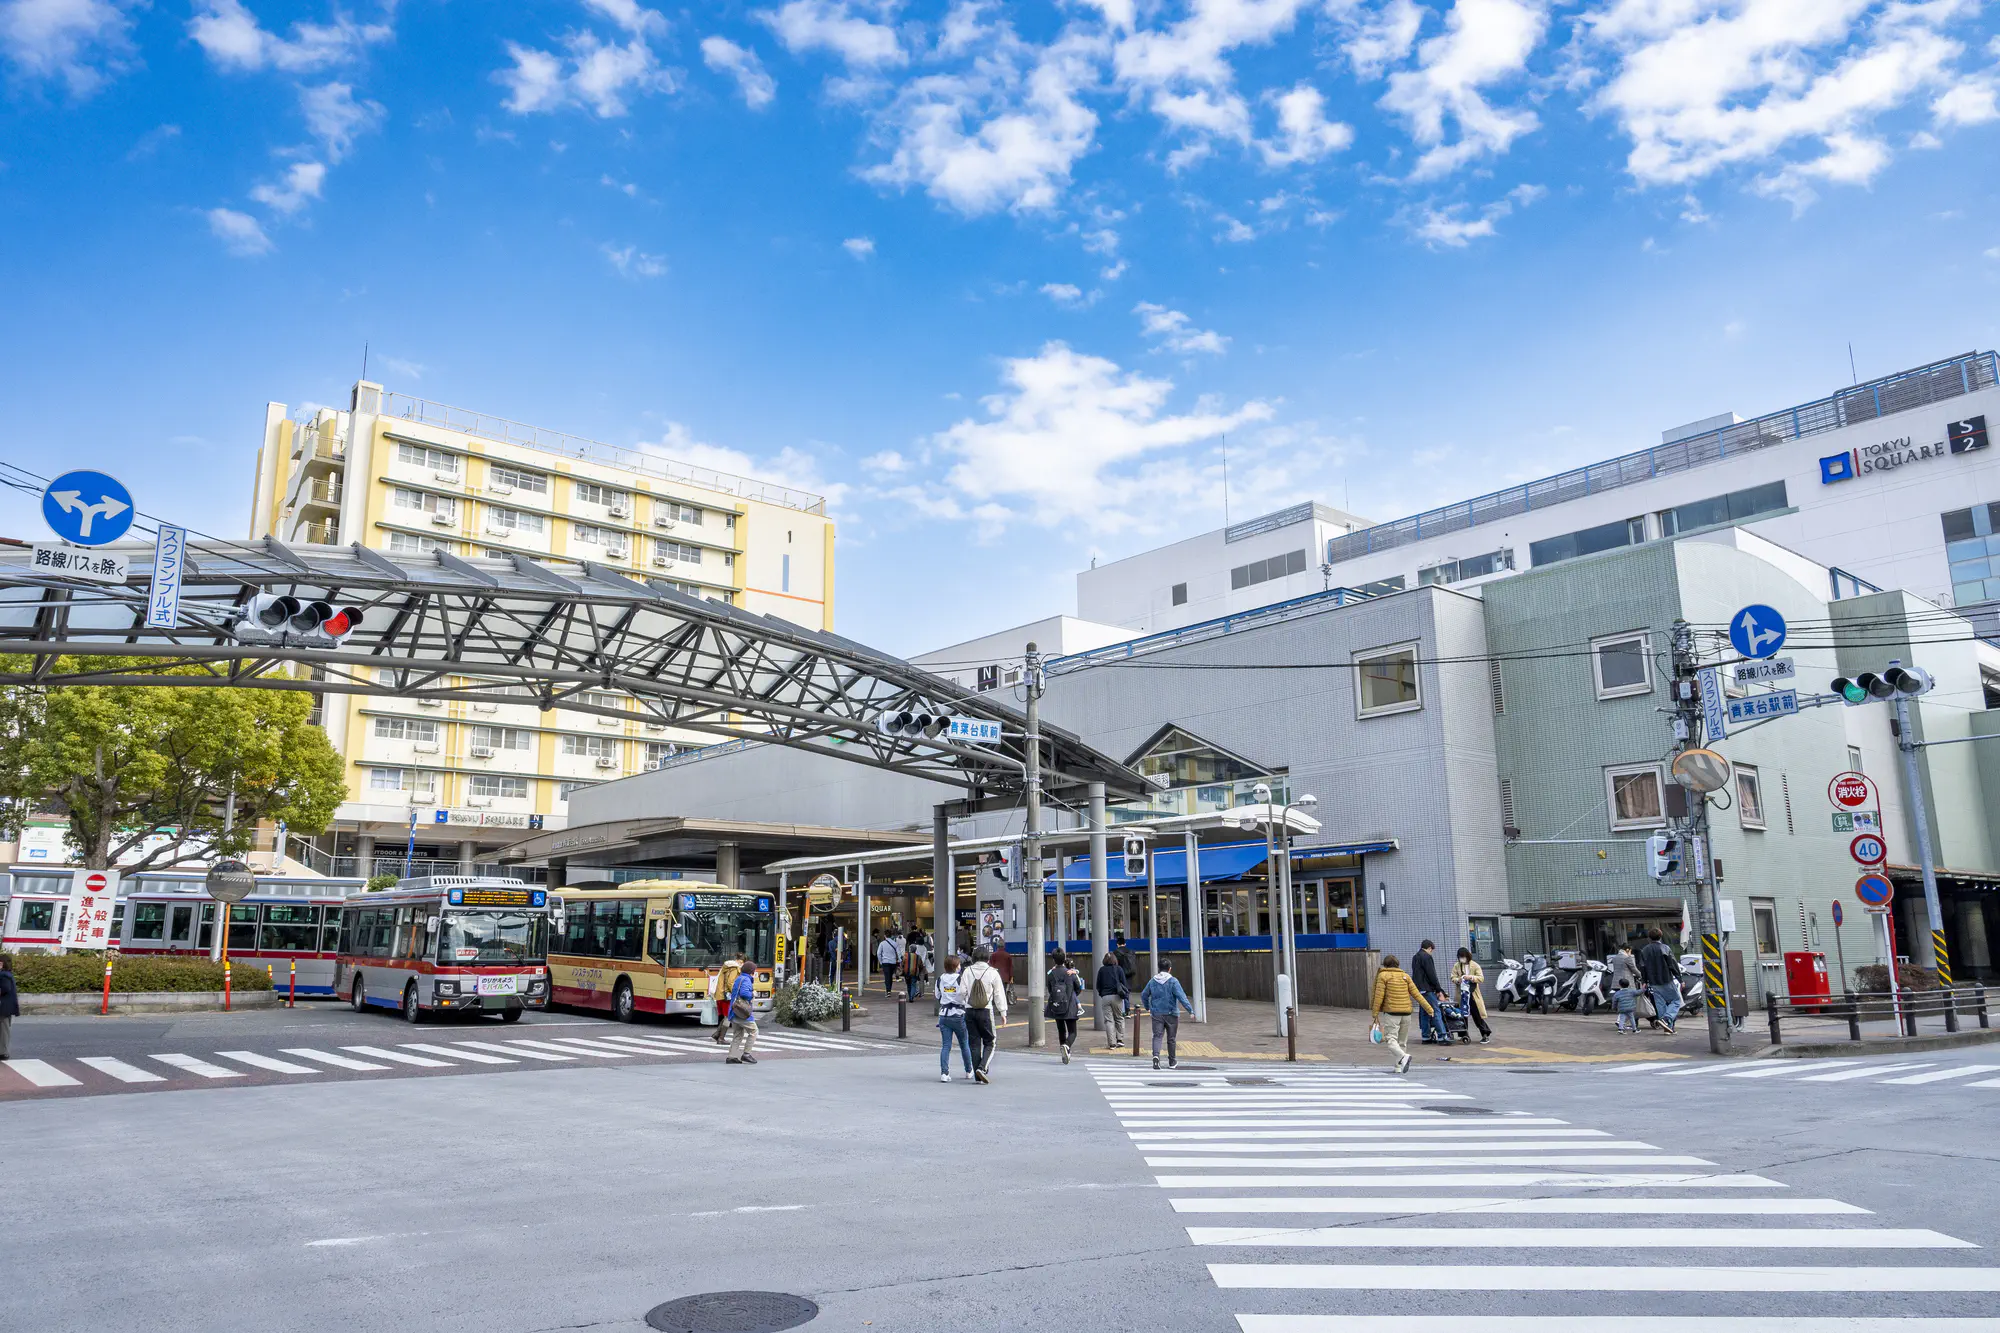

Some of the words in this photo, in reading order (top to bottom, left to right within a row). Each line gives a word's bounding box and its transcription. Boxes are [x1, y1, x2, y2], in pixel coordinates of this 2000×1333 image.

[1959, 420, 1973, 434] S
[1861, 435, 1911, 458] TOKYU
[1963, 437, 1975, 451] 2
[1863, 441, 1945, 475] SQUARE
[35, 548, 125, 577] 路線バスを除く
[155, 530, 178, 623] スクランブル式
[983, 666, 992, 680] N
[1737, 662, 1793, 681] 路線バスを除く
[1703, 671, 1721, 736] スクランブル式
[1731, 695, 1794, 718] 青葉台駅前
[950, 721, 998, 739] 青葉台駅前
[1837, 786, 1866, 798] 消火栓
[485, 816, 525, 827] SQUARE
[1859, 843, 1879, 857] 40
[74, 896, 94, 942] 進入禁止
[91, 897, 110, 938] 一般車
